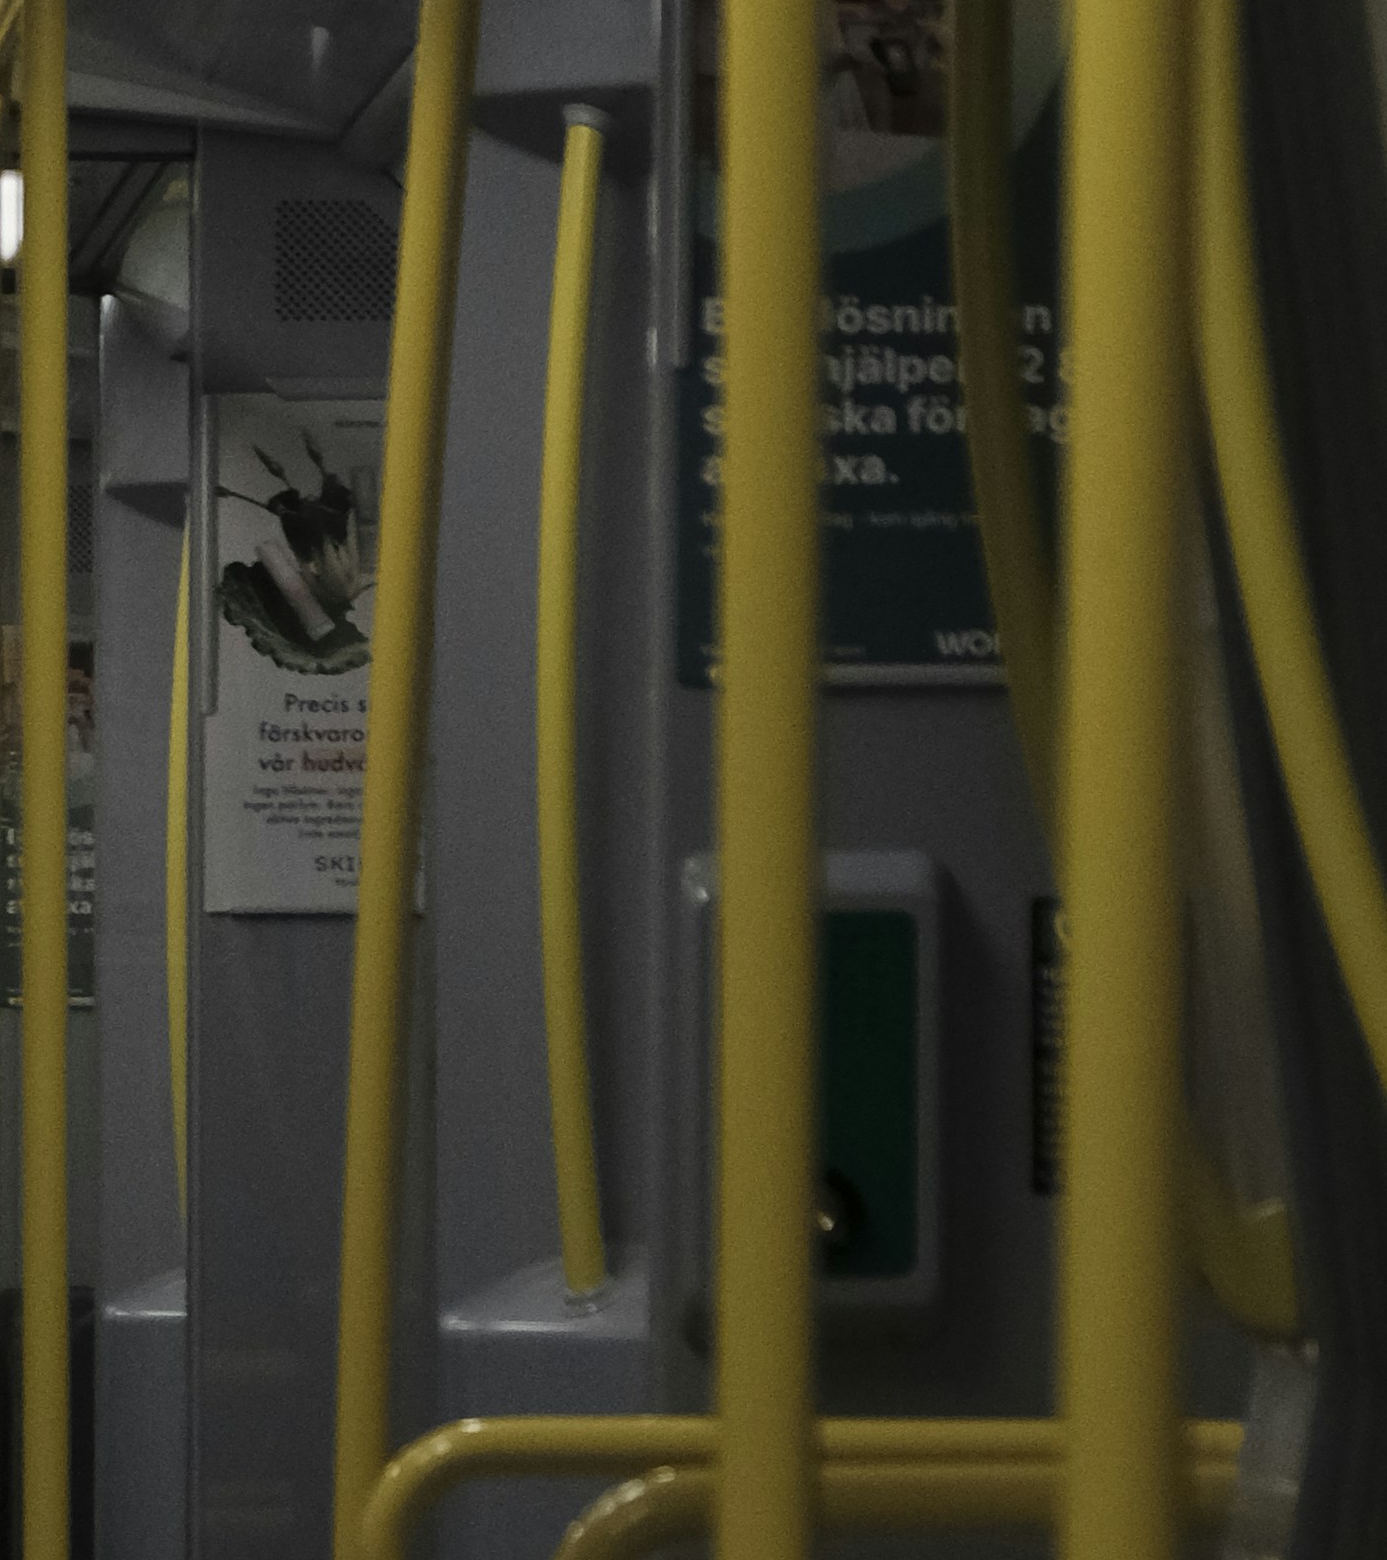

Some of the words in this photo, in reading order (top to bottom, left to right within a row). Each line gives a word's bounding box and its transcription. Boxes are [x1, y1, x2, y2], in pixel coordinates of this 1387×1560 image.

[284, 691, 350, 713] Precis
[259, 720, 365, 743] färskvaro
[258, 751, 295, 773] vår
[301, 749, 367, 773] hudv
